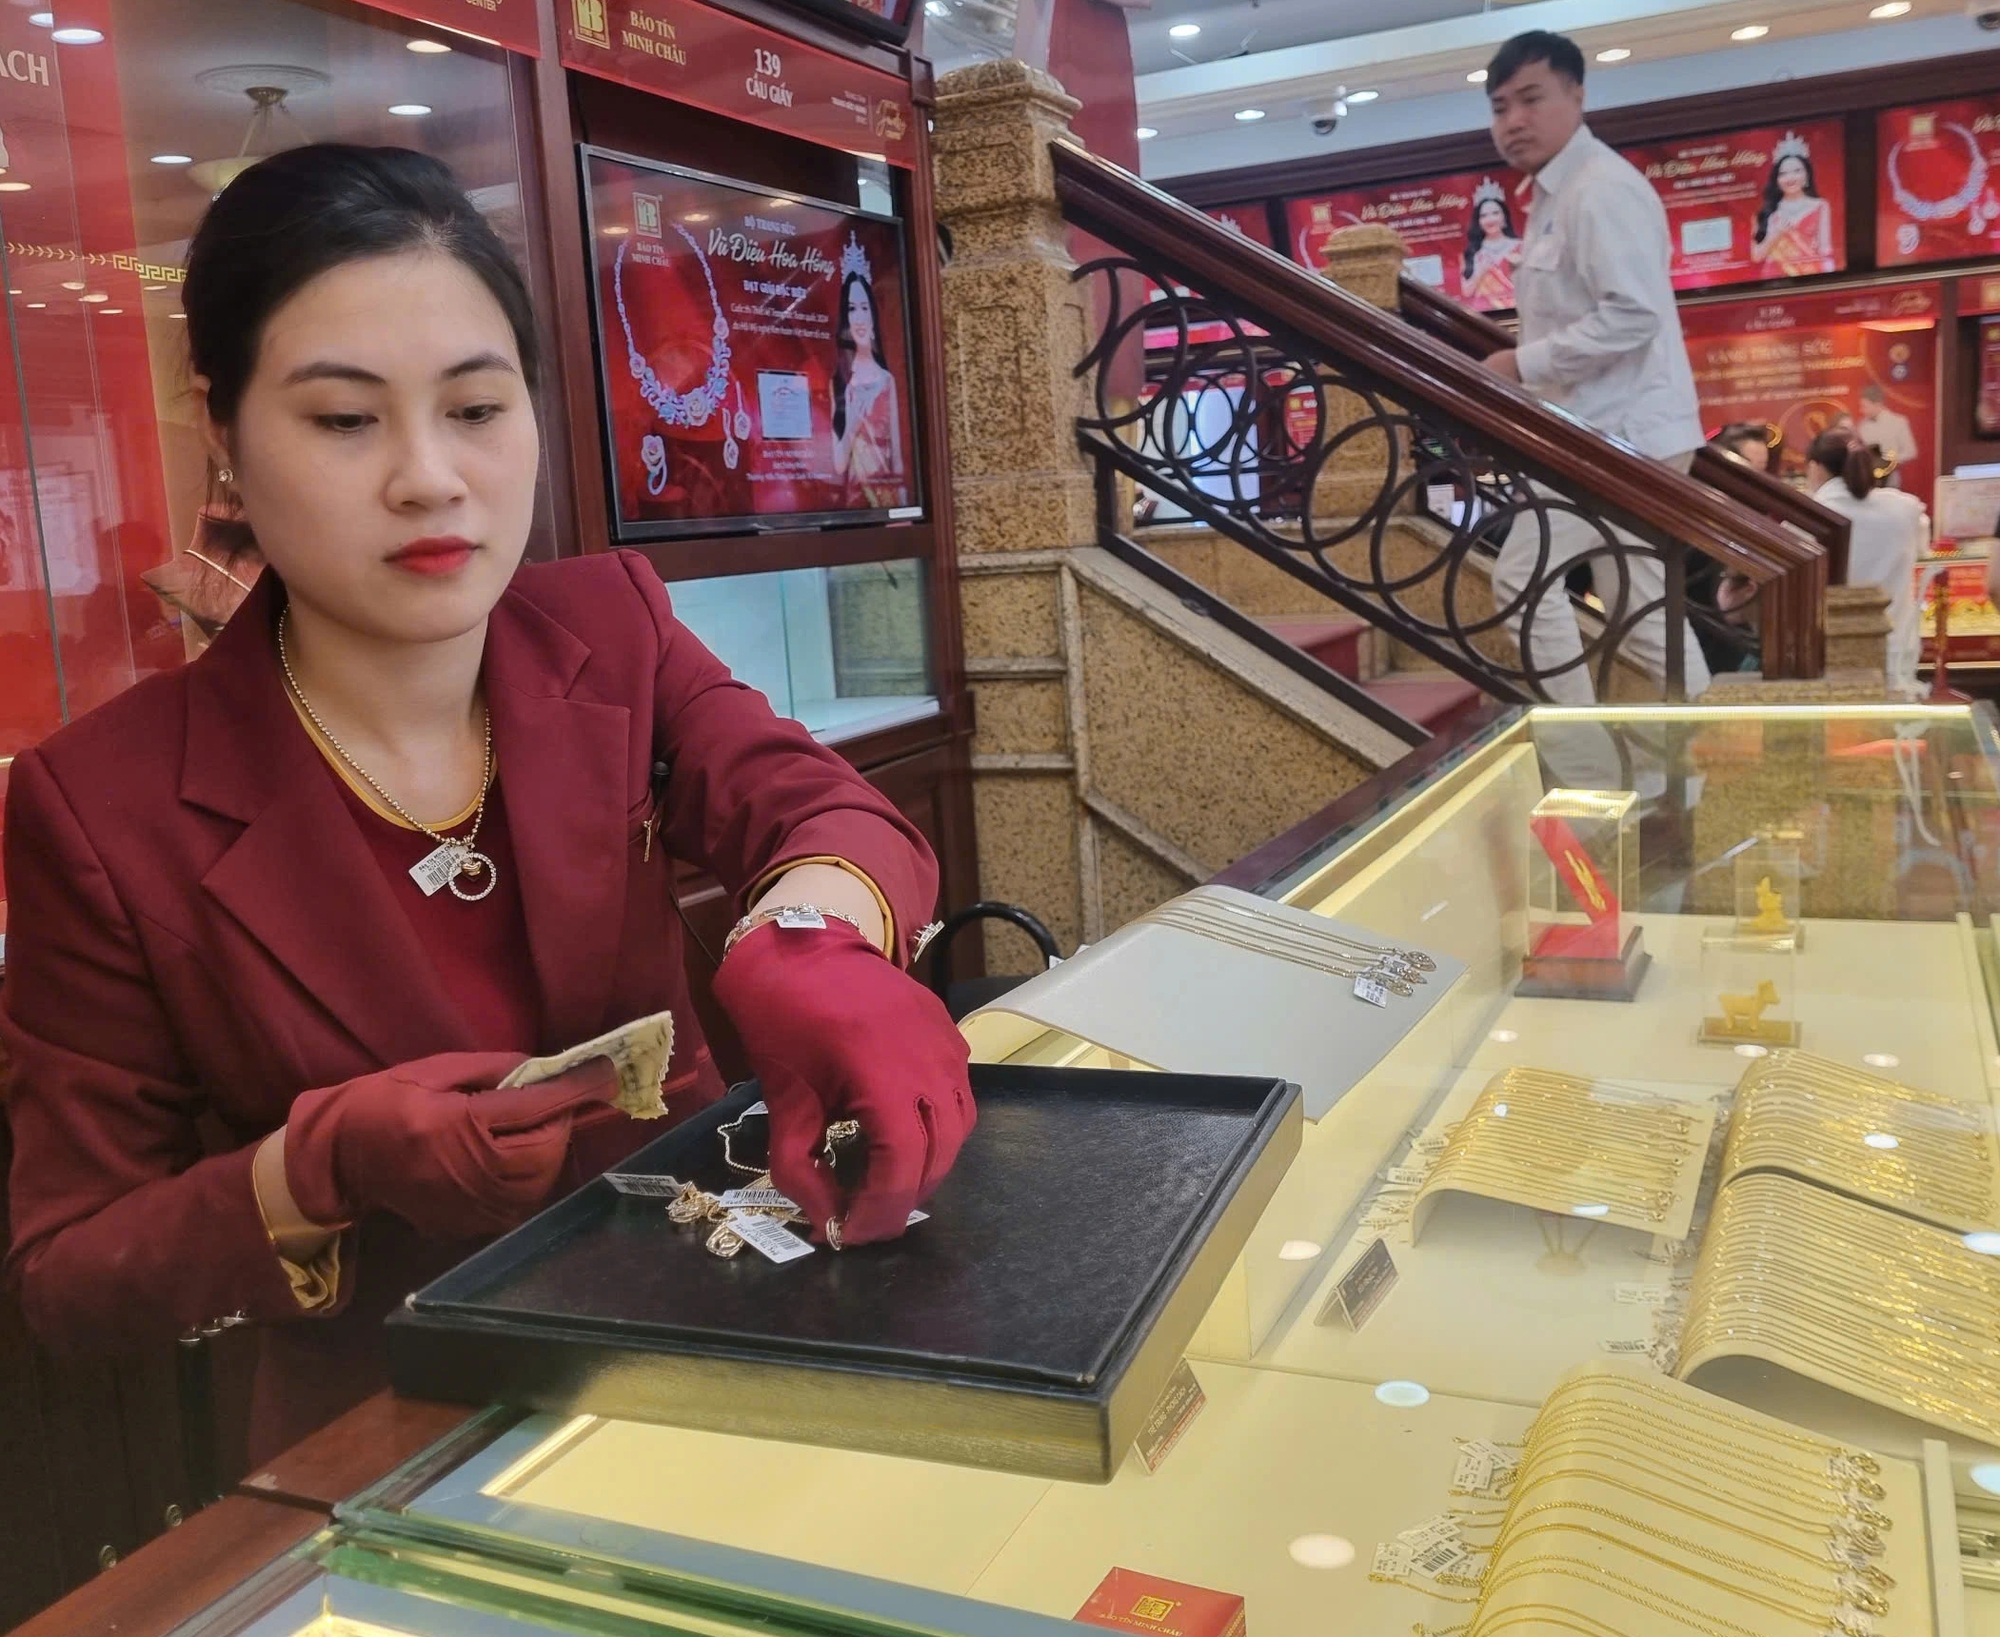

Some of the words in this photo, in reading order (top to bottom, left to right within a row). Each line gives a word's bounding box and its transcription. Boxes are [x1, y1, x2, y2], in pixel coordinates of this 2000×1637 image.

[630, 9, 655, 33] BẢO
[655, 18, 676, 40] TÍN
[621, 30, 654, 55] MINH
[655, 44, 687, 66] CHÂU
[754, 48, 781, 78] 139
[728, 232, 766, 266] Điệu
[767, 240, 799, 269] Hoa
[800, 246, 836, 282] Hồng
